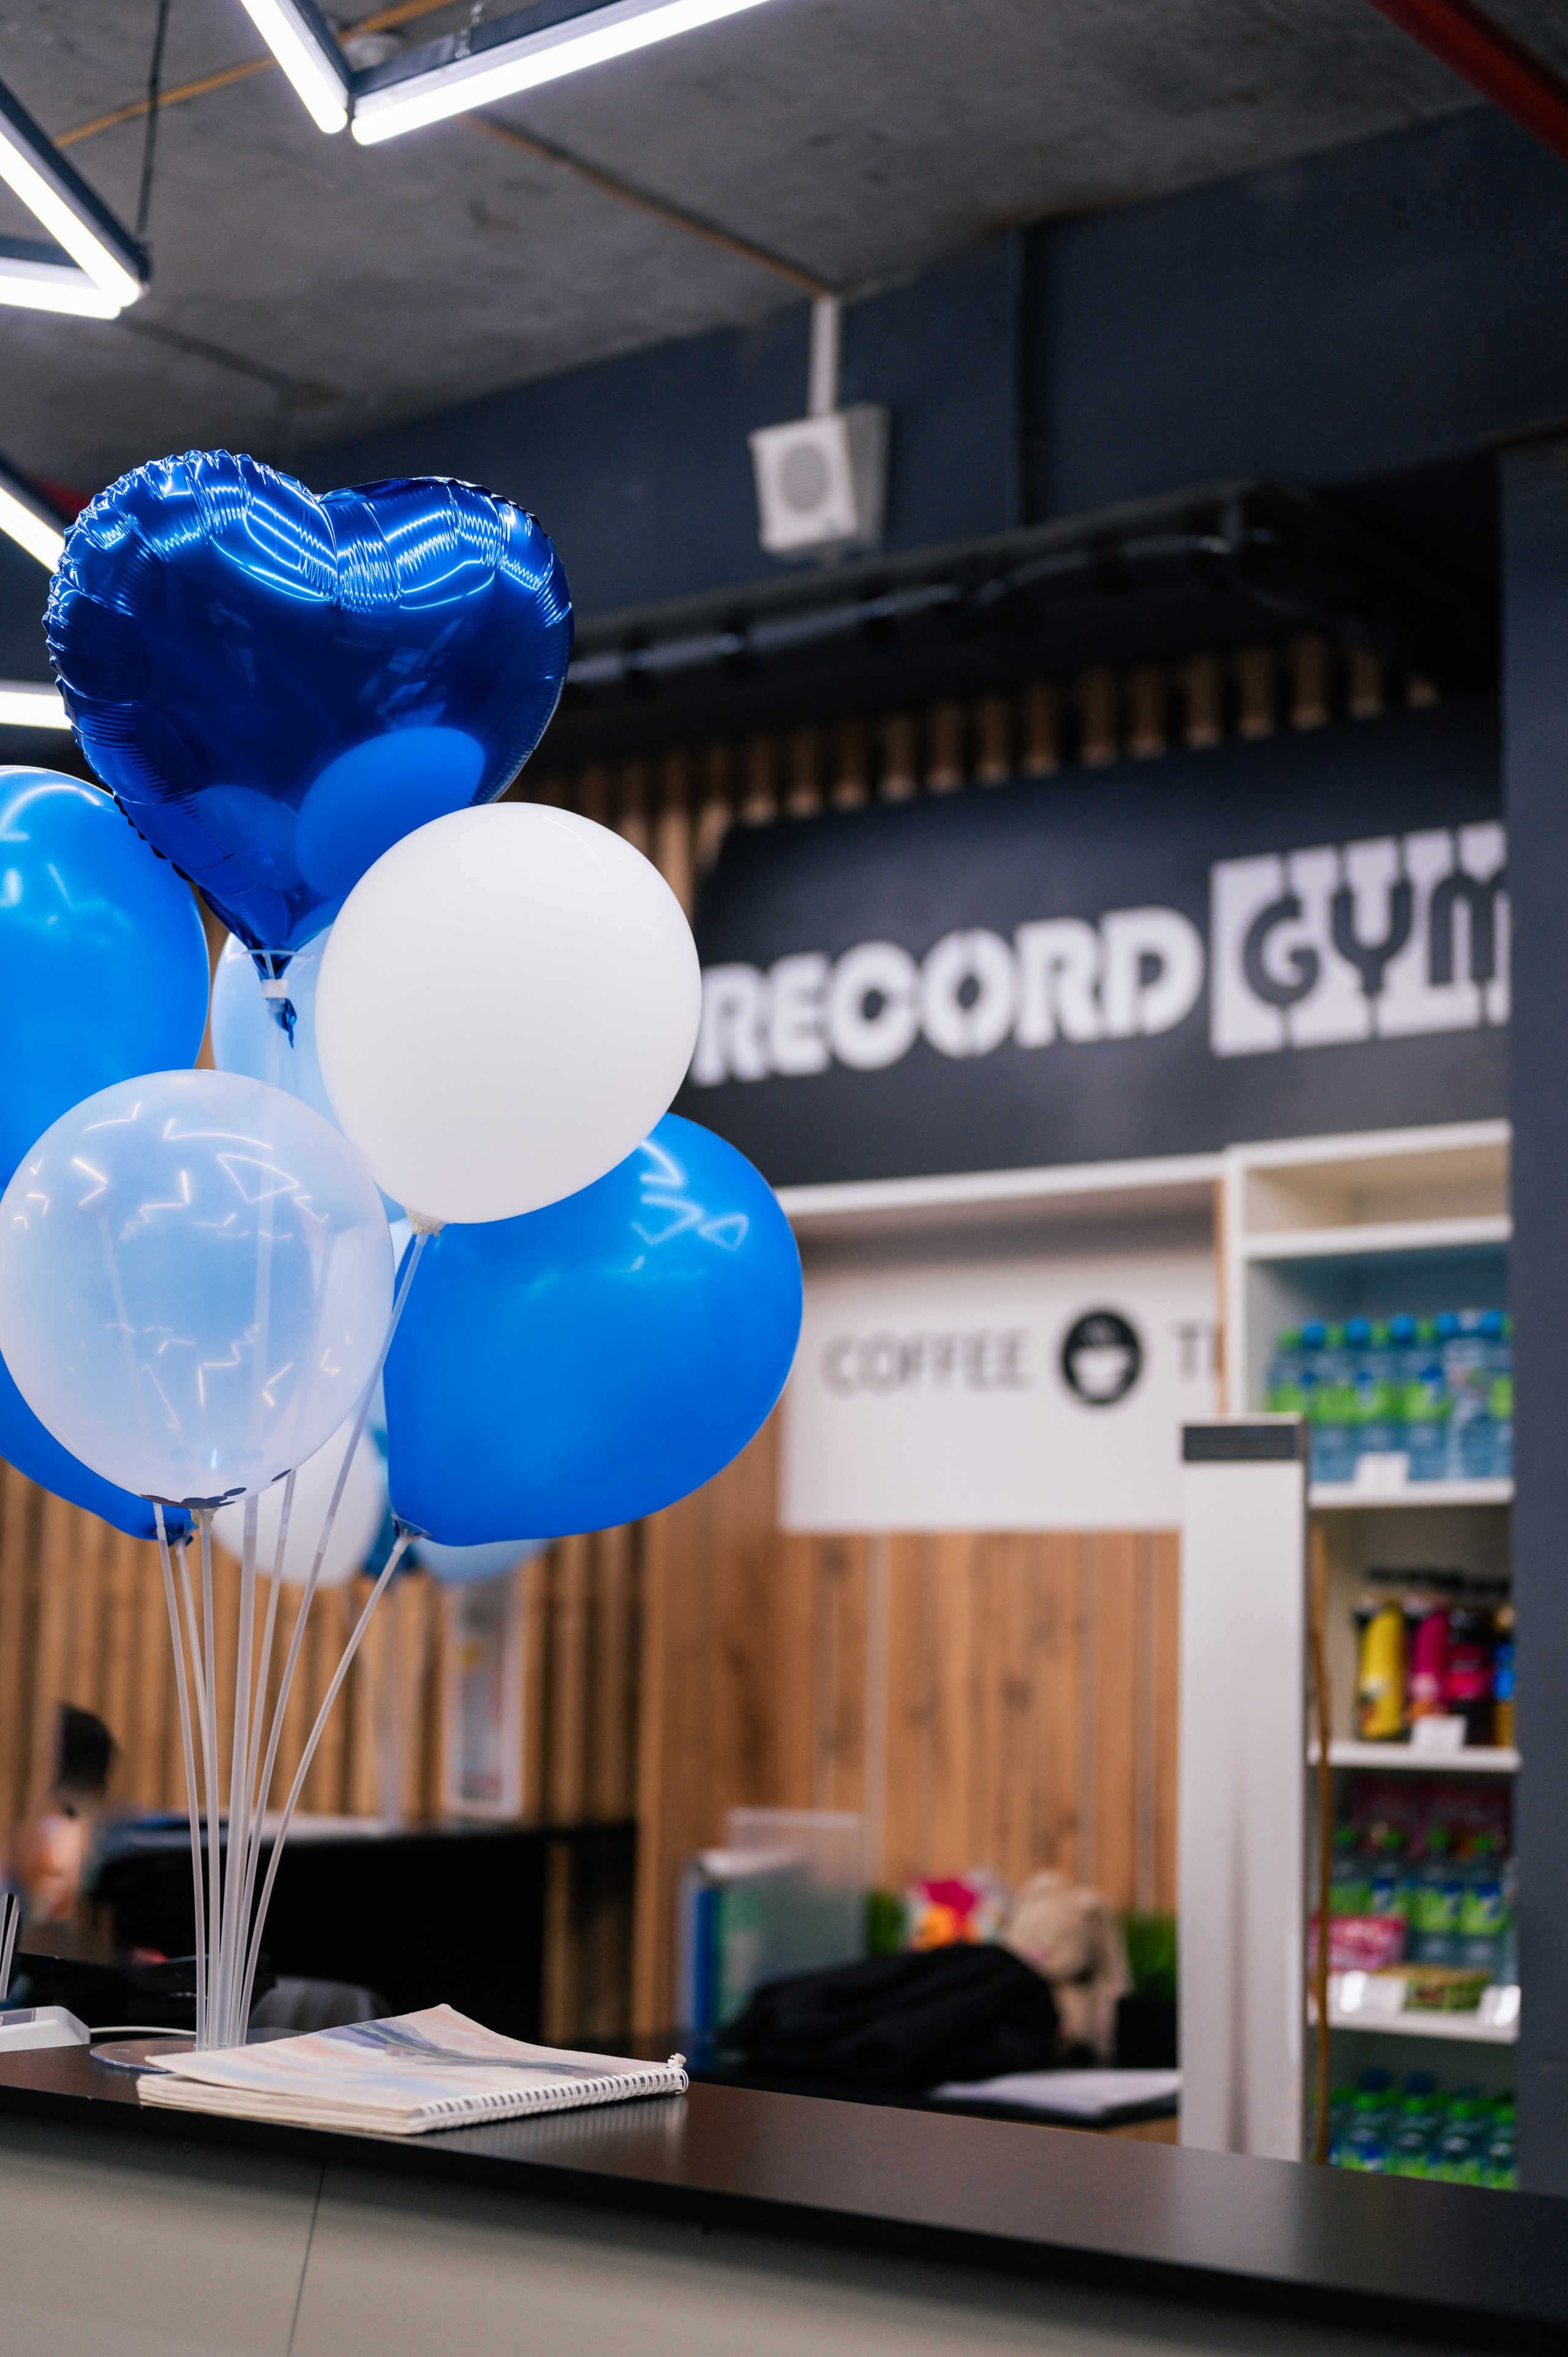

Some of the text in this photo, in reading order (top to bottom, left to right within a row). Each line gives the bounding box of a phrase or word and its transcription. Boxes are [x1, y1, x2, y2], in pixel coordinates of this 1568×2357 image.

[690, 858, 1510, 1088] RECORD GYM
[820, 1325, 1031, 1395] COFFEE
